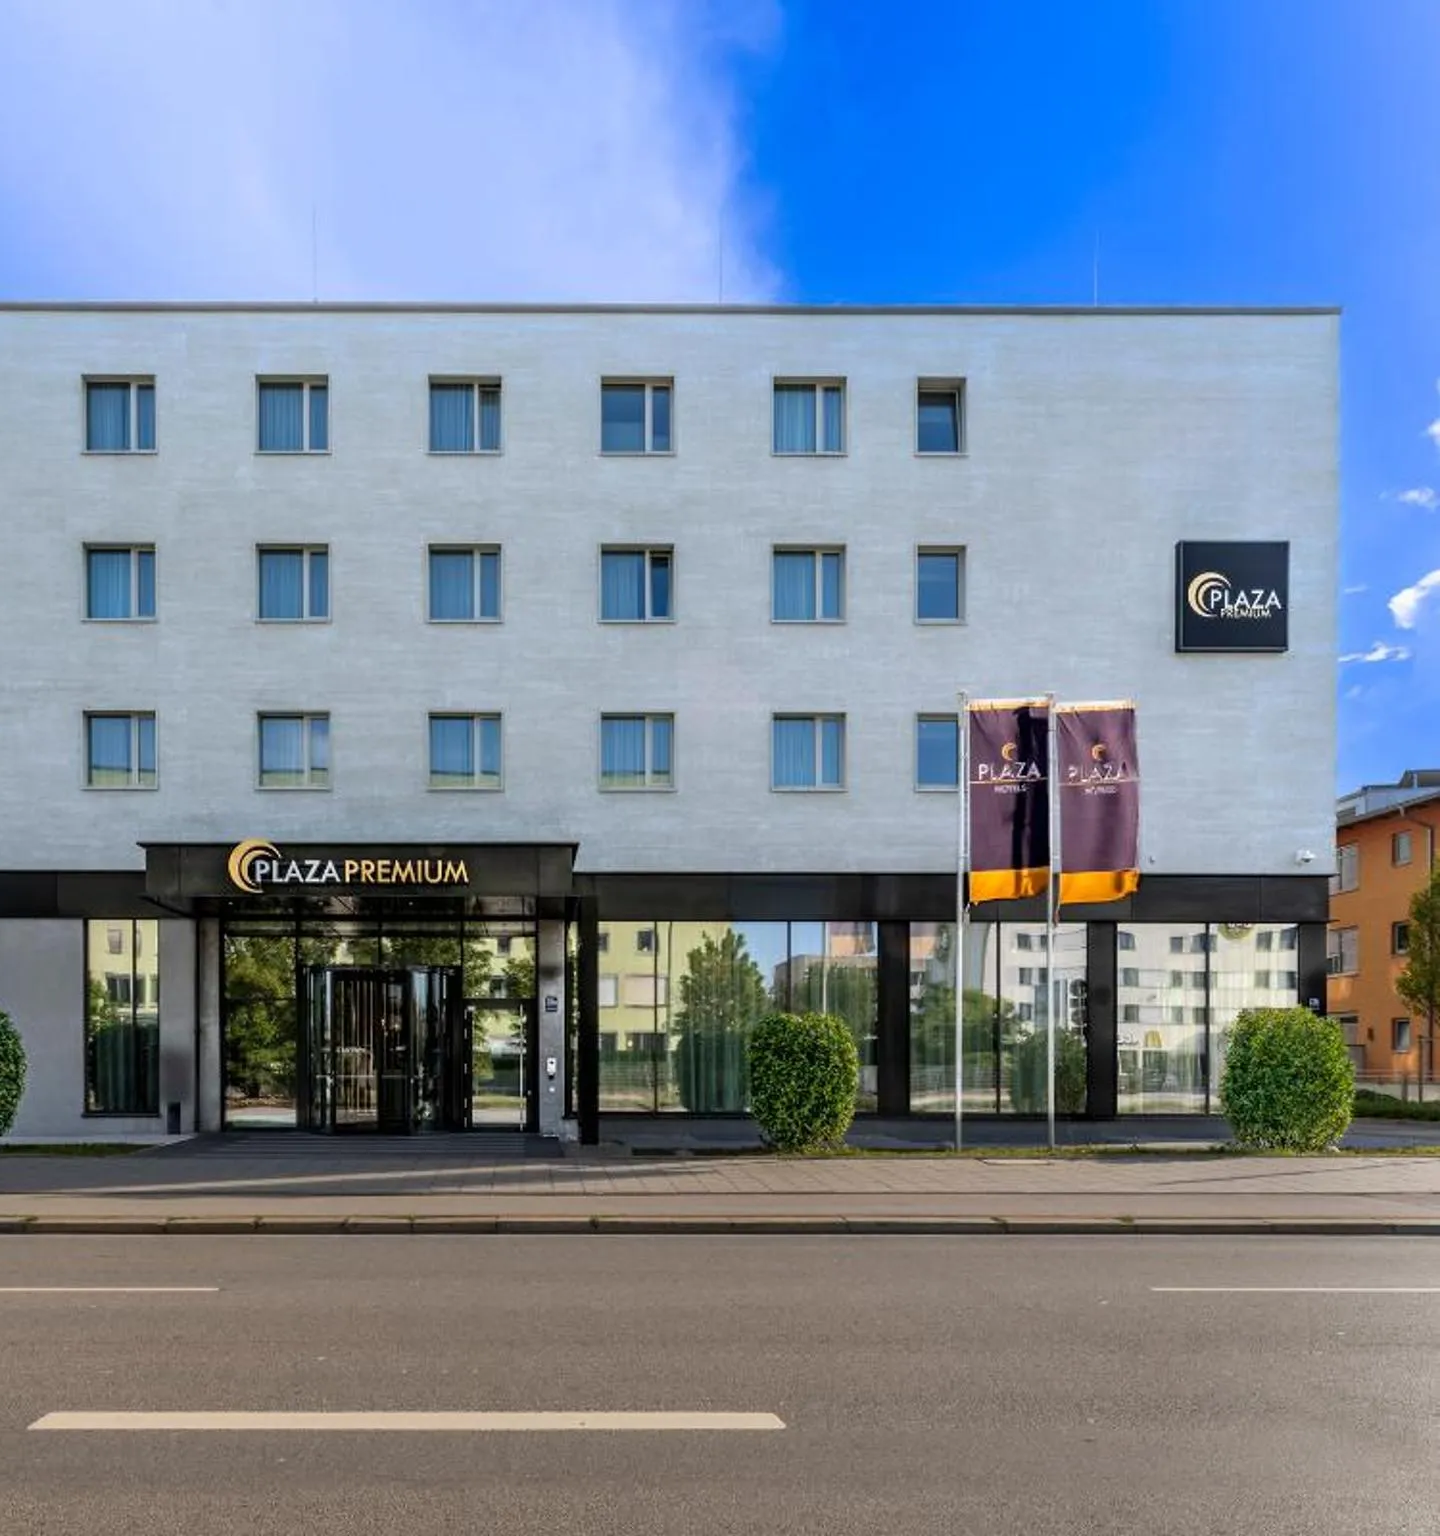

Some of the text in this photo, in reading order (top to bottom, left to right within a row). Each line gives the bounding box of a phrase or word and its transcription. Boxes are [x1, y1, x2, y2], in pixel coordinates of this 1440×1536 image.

[1210, 589, 1282, 610] PLAZA
[1220, 607, 1272, 619] PREMIUM
[978, 761, 1041, 781] PLAZA
[255, 859, 469, 884] PLAZA PREMIUM
